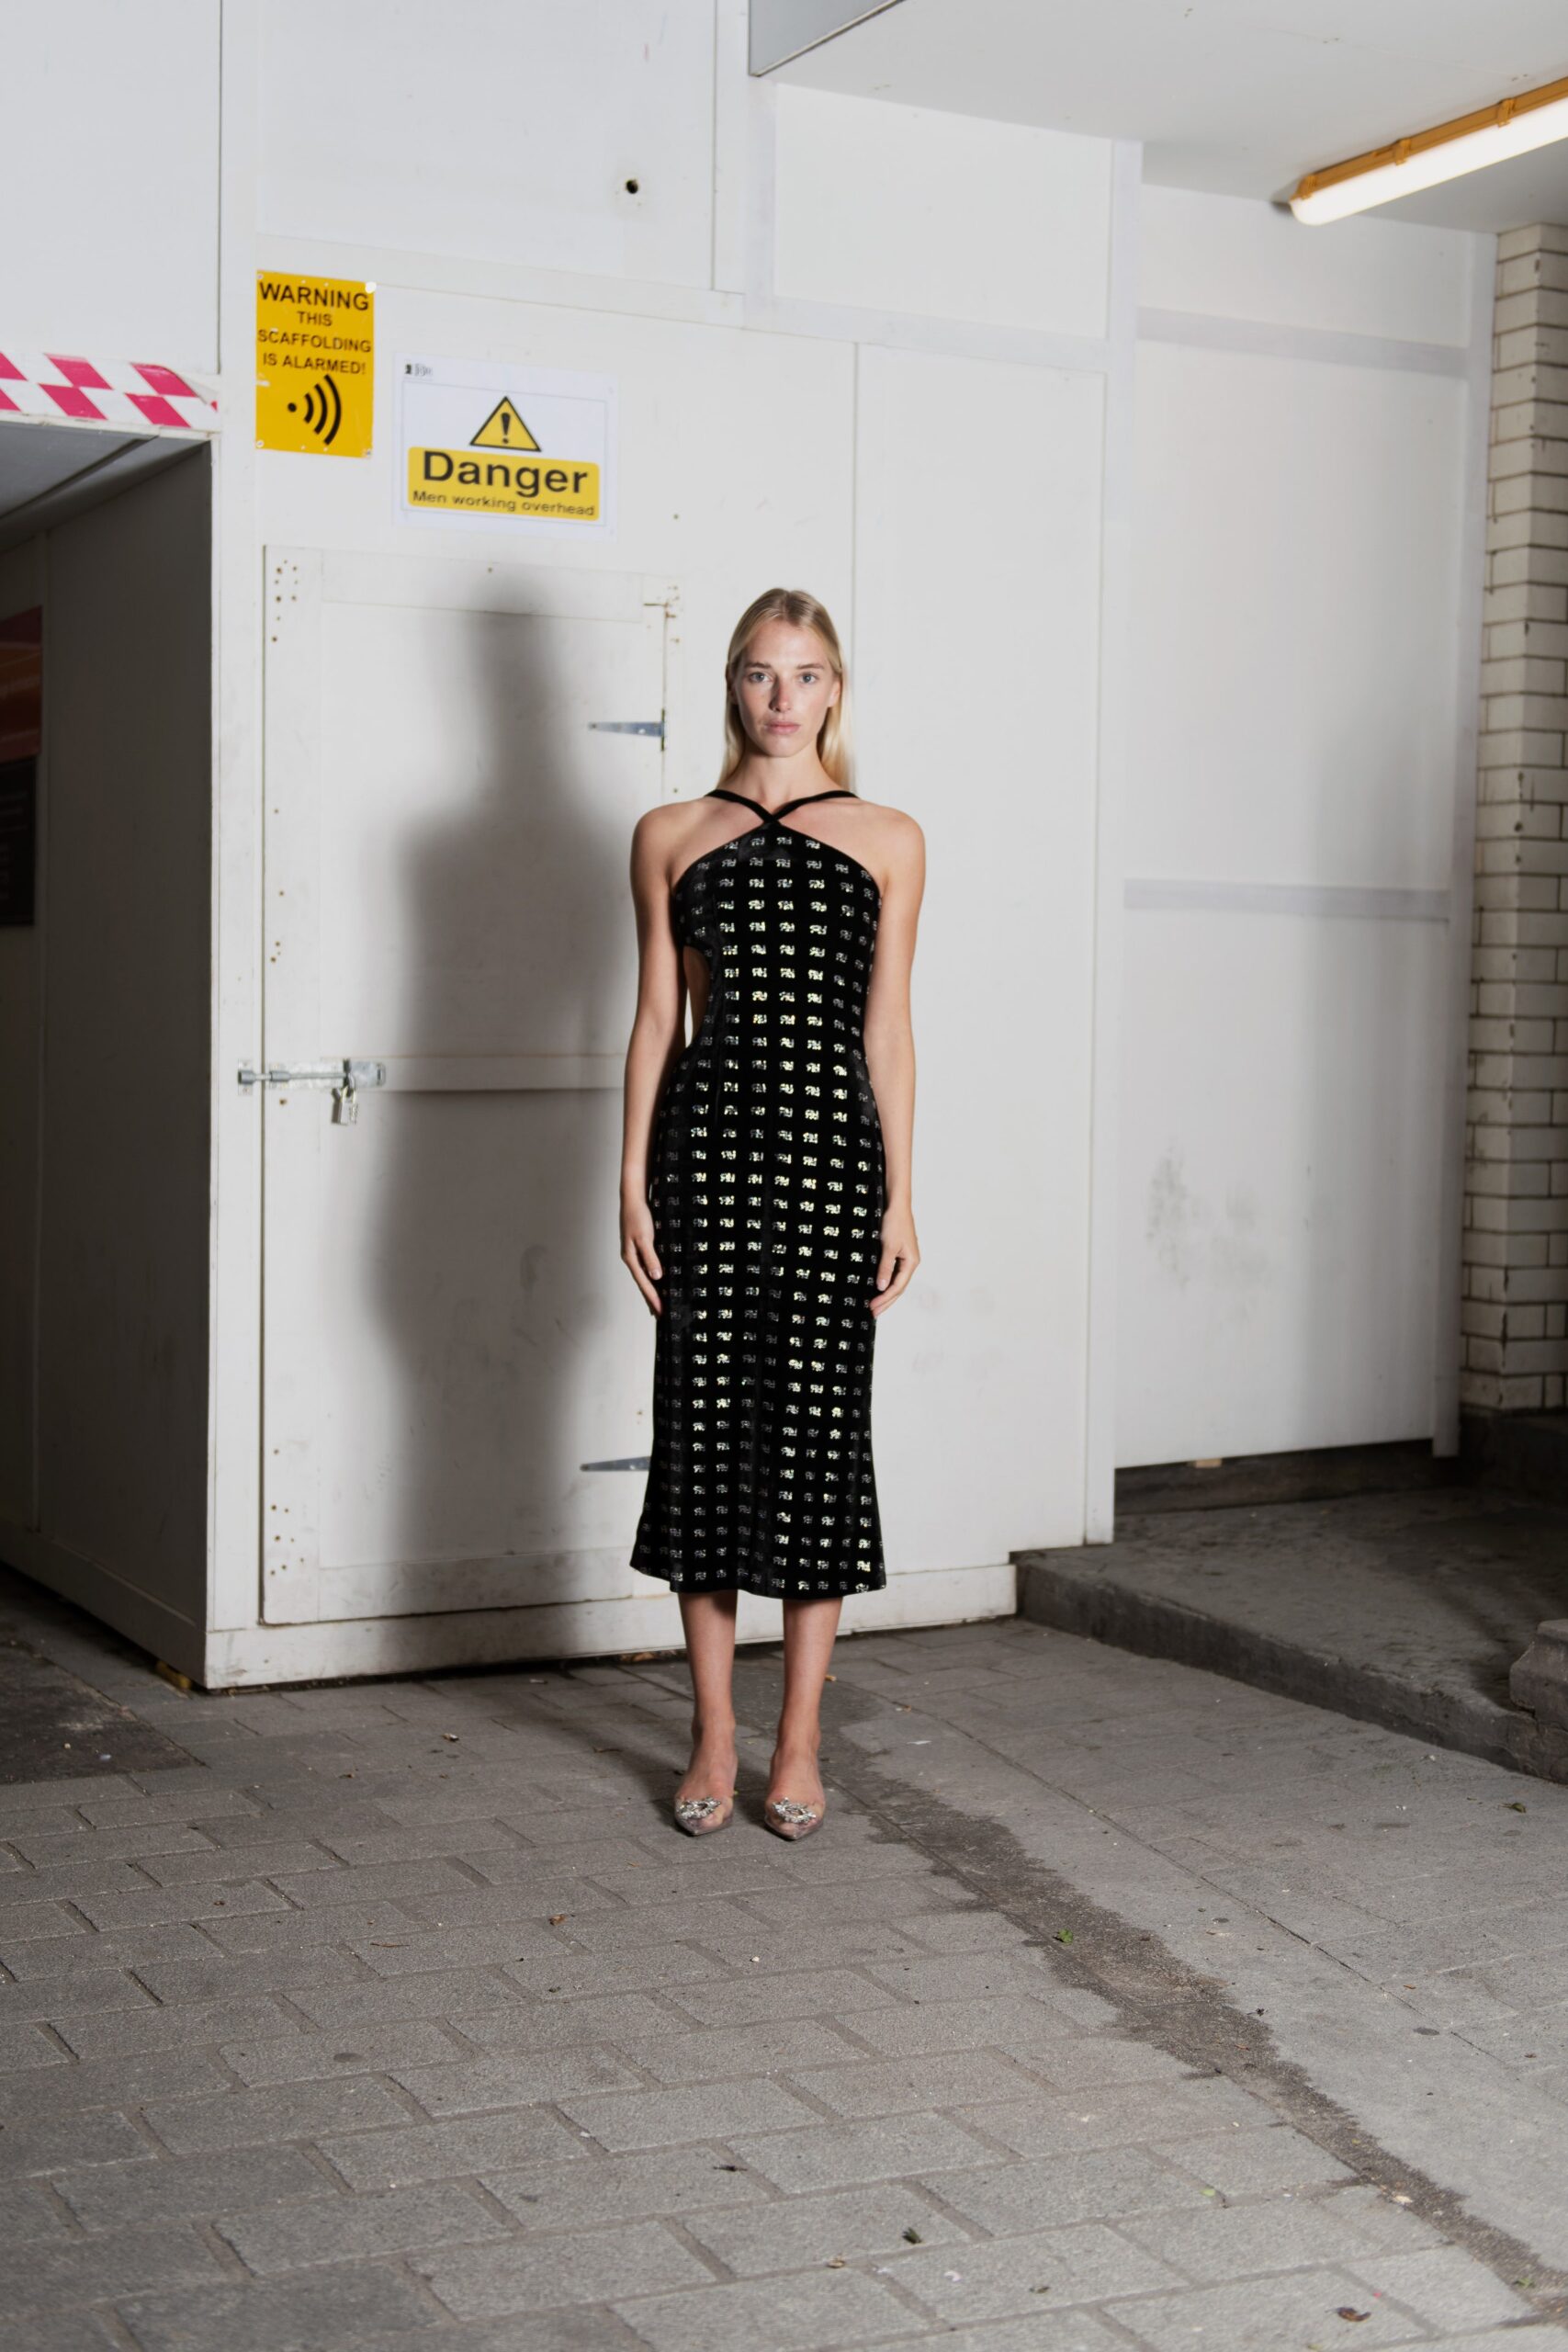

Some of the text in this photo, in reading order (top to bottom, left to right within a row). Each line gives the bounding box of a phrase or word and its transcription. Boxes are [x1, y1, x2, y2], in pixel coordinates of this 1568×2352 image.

[259, 281, 369, 311] WARNING
[298, 311, 333, 326] THIS
[258, 329, 371, 353] SCAFFOLDING
[263, 353, 367, 374] IS ALARMED!
[423, 450, 588, 498] Danger
[413, 490, 595, 516] Men working overhead
